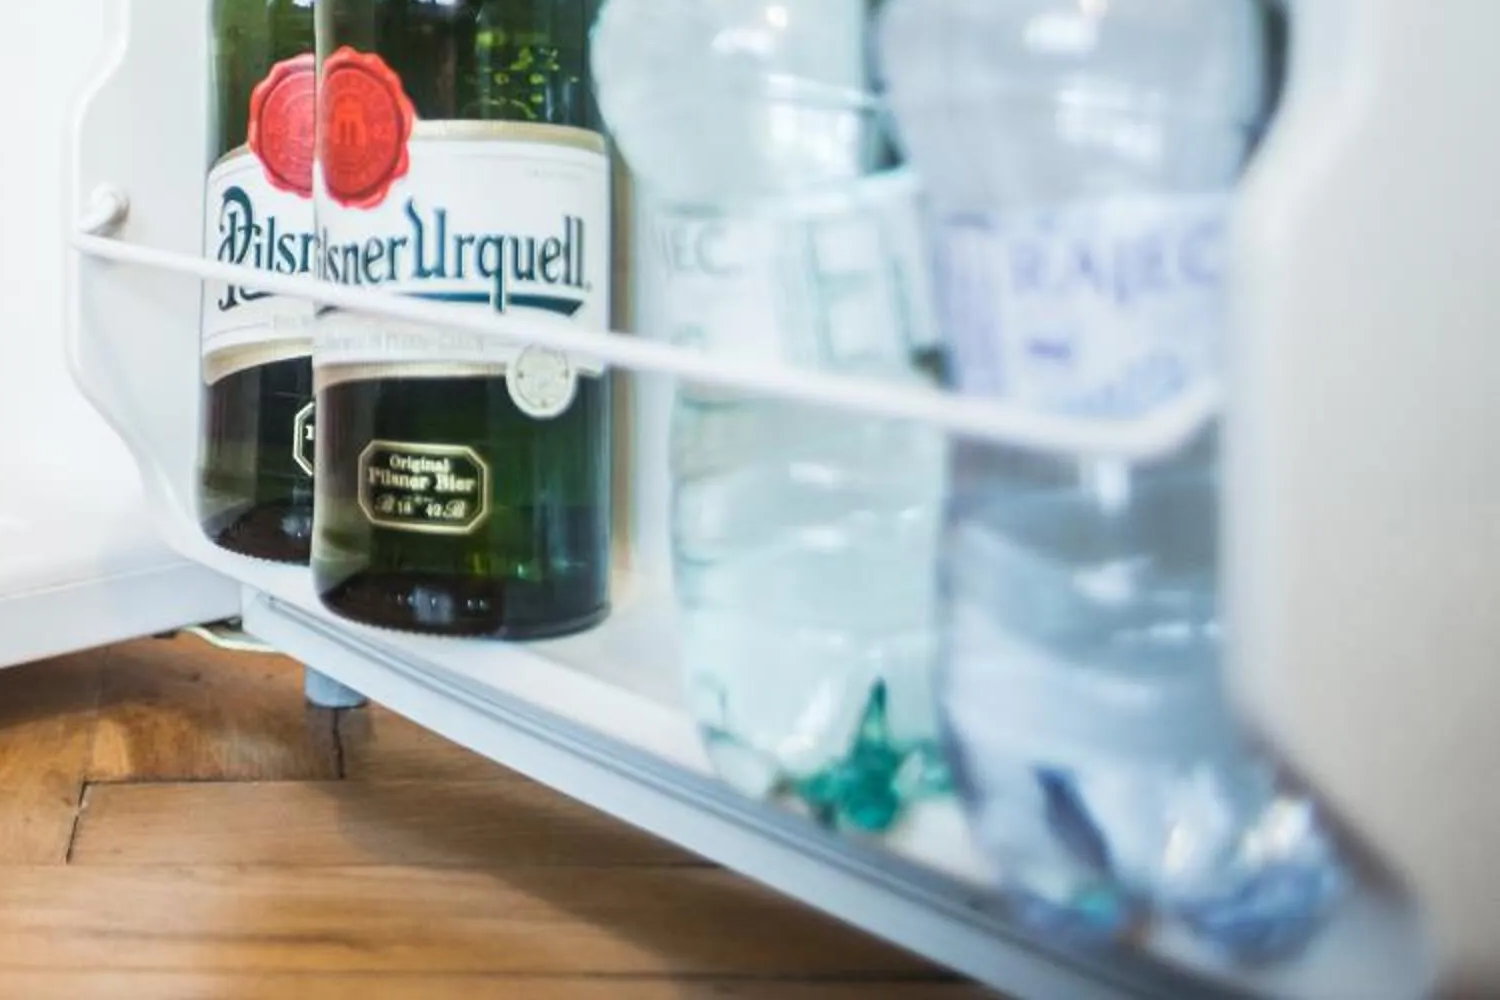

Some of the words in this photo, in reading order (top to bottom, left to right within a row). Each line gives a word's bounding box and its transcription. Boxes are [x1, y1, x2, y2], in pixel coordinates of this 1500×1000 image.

[317, 227, 407, 284] ilsner
[406, 196, 584, 314] Urquell
[389, 455, 451, 474] Original
[368, 467, 429, 491] Pilsner
[435, 473, 475, 492] Bier
